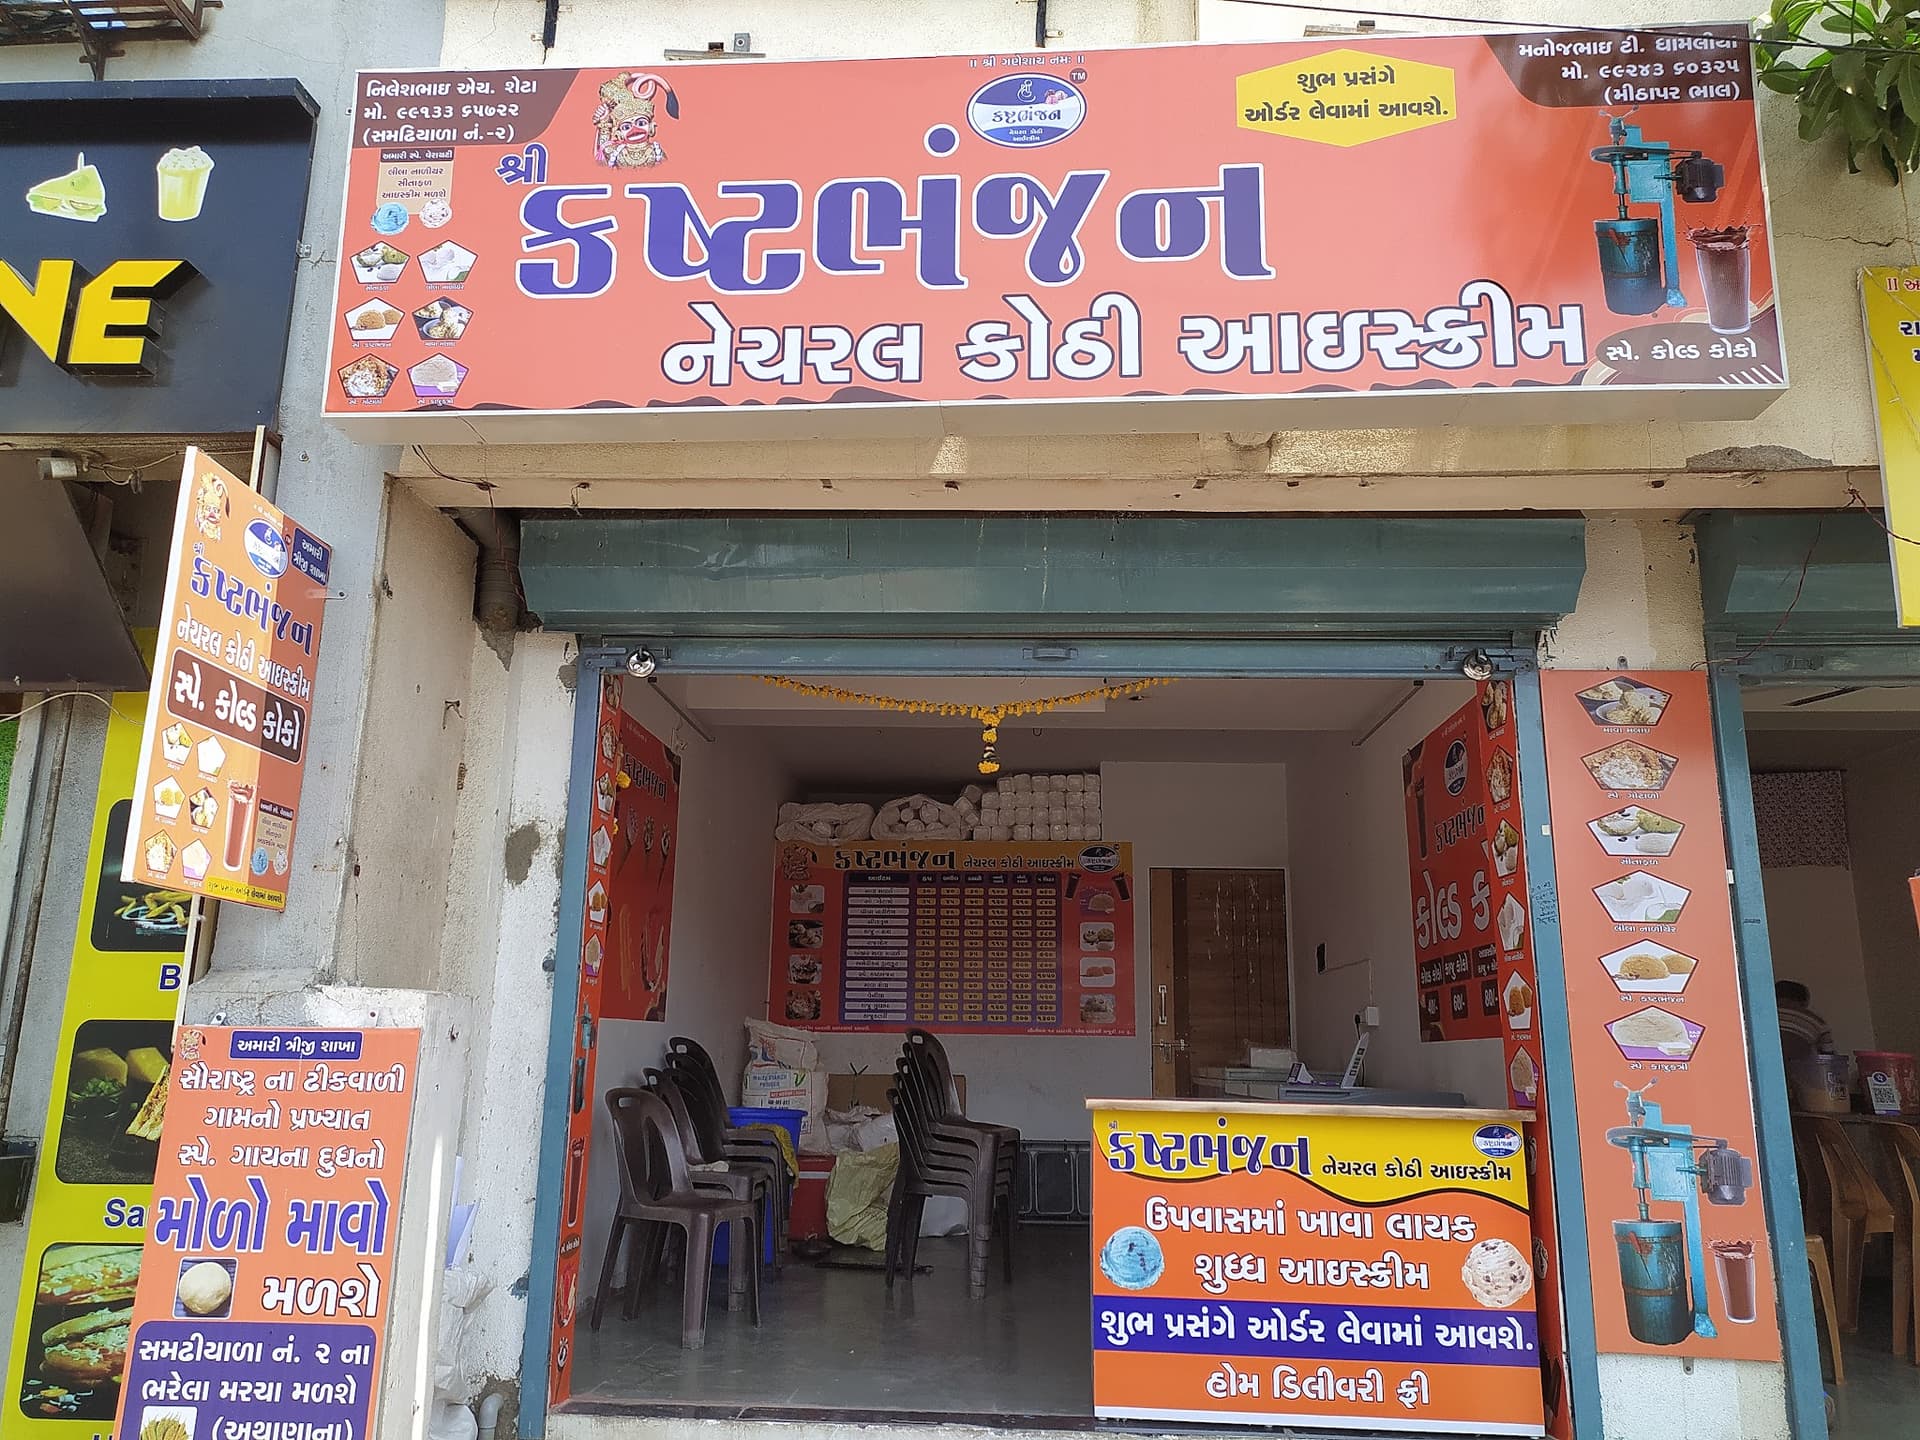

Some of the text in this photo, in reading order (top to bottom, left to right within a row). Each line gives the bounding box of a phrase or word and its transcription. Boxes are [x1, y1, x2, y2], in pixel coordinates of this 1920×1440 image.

[1001, 54, 1046, 67] ગણેશાય
[1518, 38, 1613, 58] મનોજભાઇ
[1619, 35, 1645, 54] ટી.
[366, 76, 538, 98] નિલેશભાઇ એચ. શેટા
[1072, 72, 1087, 81] TM
[1296, 65, 1396, 93] શુભ પ્રસંગે
[1561, 64, 1589, 82] મો.
[1598, 62, 1665, 77] ૯૯૨૪૩
[363, 102, 520, 120] મો. ૯૯૧૩૩ ૬૫૭૨૨
[1244, 94, 1449, 124] ઓર્ડર લેવામાં આવશે.
[1603, 83, 1741, 106] (મીઠાપર ભાલ)
[362, 125, 458, 146] (સમઢિયાળા
[496, 143, 549, 185] શ્રી
[515, 122, 1276, 299] કષ્ટભંજન
[661, 279, 1589, 387] નેચરલ કોઠી આઇસ્ક્રીમ
[1605, 337, 1758, 361] સ્પે. કોલ્ડ કોકો
[190, 556, 314, 657] કષ્ટભંજન
[176, 602, 223, 658] નેચરલ
[225, 630, 256, 674] કોઠી
[174, 662, 301, 751] સ્પે. કોલ્ડ કોકો
[834, 842, 956, 871] કષ્ટભંજન
[963, 855, 997, 868] નેચરલ
[1000, 851, 1023, 869] કોઠી
[237, 1036, 356, 1056] અમારી ત્રીજી શાખા
[263, 1070, 294, 1092] ના
[203, 1099, 371, 1132] ગામનો પ્રખ્યાત
[177, 1136, 386, 1178] સ્પે. ગાયના દુધનો
[1107, 1117, 1313, 1176] કષ્ટભંજન
[1321, 1154, 1377, 1177] નેચરલ
[1384, 1157, 1423, 1179] કોઠી
[104, 1199, 150, 1228] Sa
[154, 1174, 391, 1256] મોળો માવો
[1145, 1196, 1477, 1242] ઉપવાસમાં ખાવા લાયક
[1279, 1250, 1430, 1290] આઇસ્ક્રીમ
[261, 1262, 383, 1319] મળશે
[1100, 1305, 1535, 1352] શુભ પ્રસંગે ઓર્ડર લેવામાં આવશે.
[271, 1333, 301, 1364] નં.
[340, 1344, 370, 1366] ના
[141, 1372, 358, 1405] ભરેલા મરચા મળશે
[1205, 1362, 1430, 1409] હોમ ડિલીવરી ફ્રી
